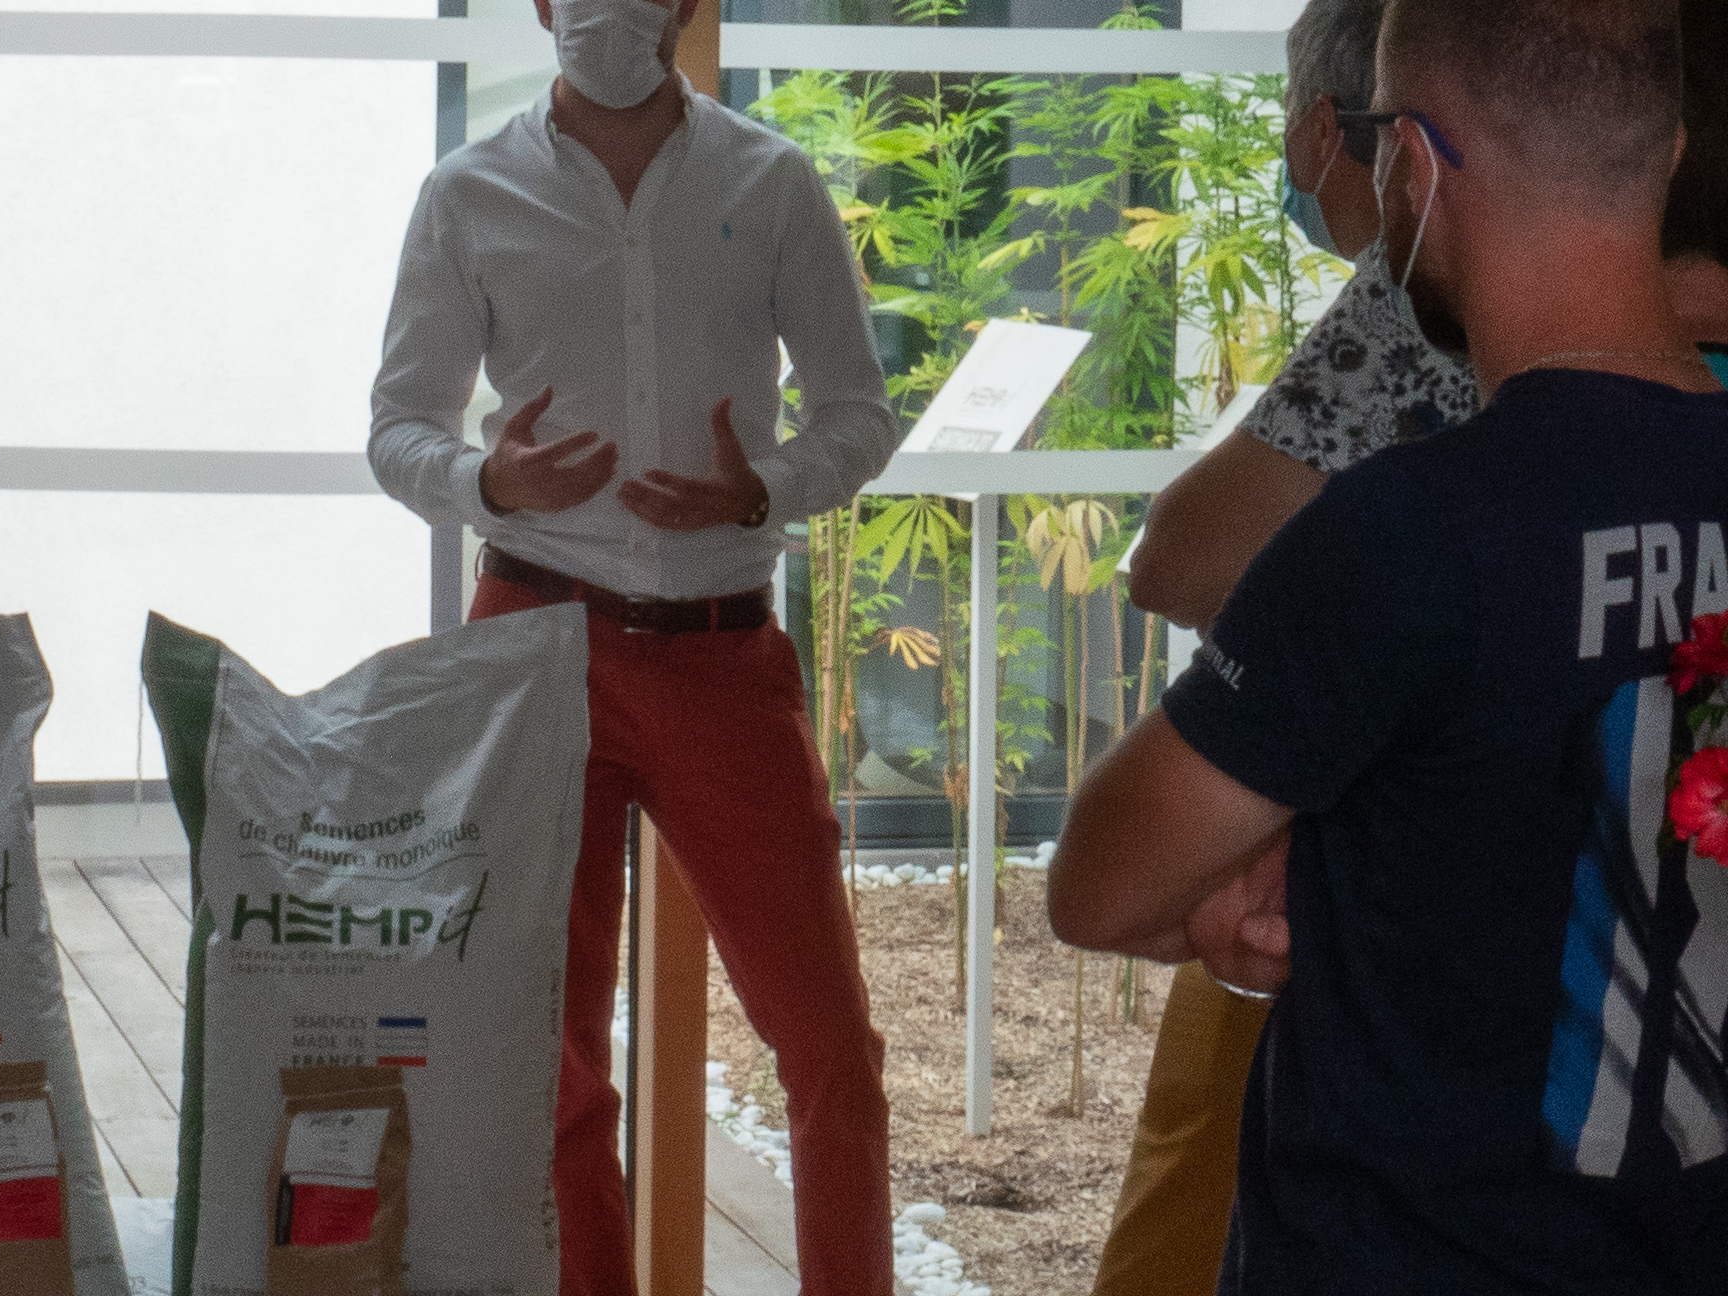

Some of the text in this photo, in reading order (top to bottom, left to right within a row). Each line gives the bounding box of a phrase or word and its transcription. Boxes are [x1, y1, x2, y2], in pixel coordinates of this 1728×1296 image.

[238, 817, 268, 842] de
[273, 832, 366, 867] chanvre
[299, 809, 427, 842] Semences
[291, 1033, 365, 1049] MADE IN
